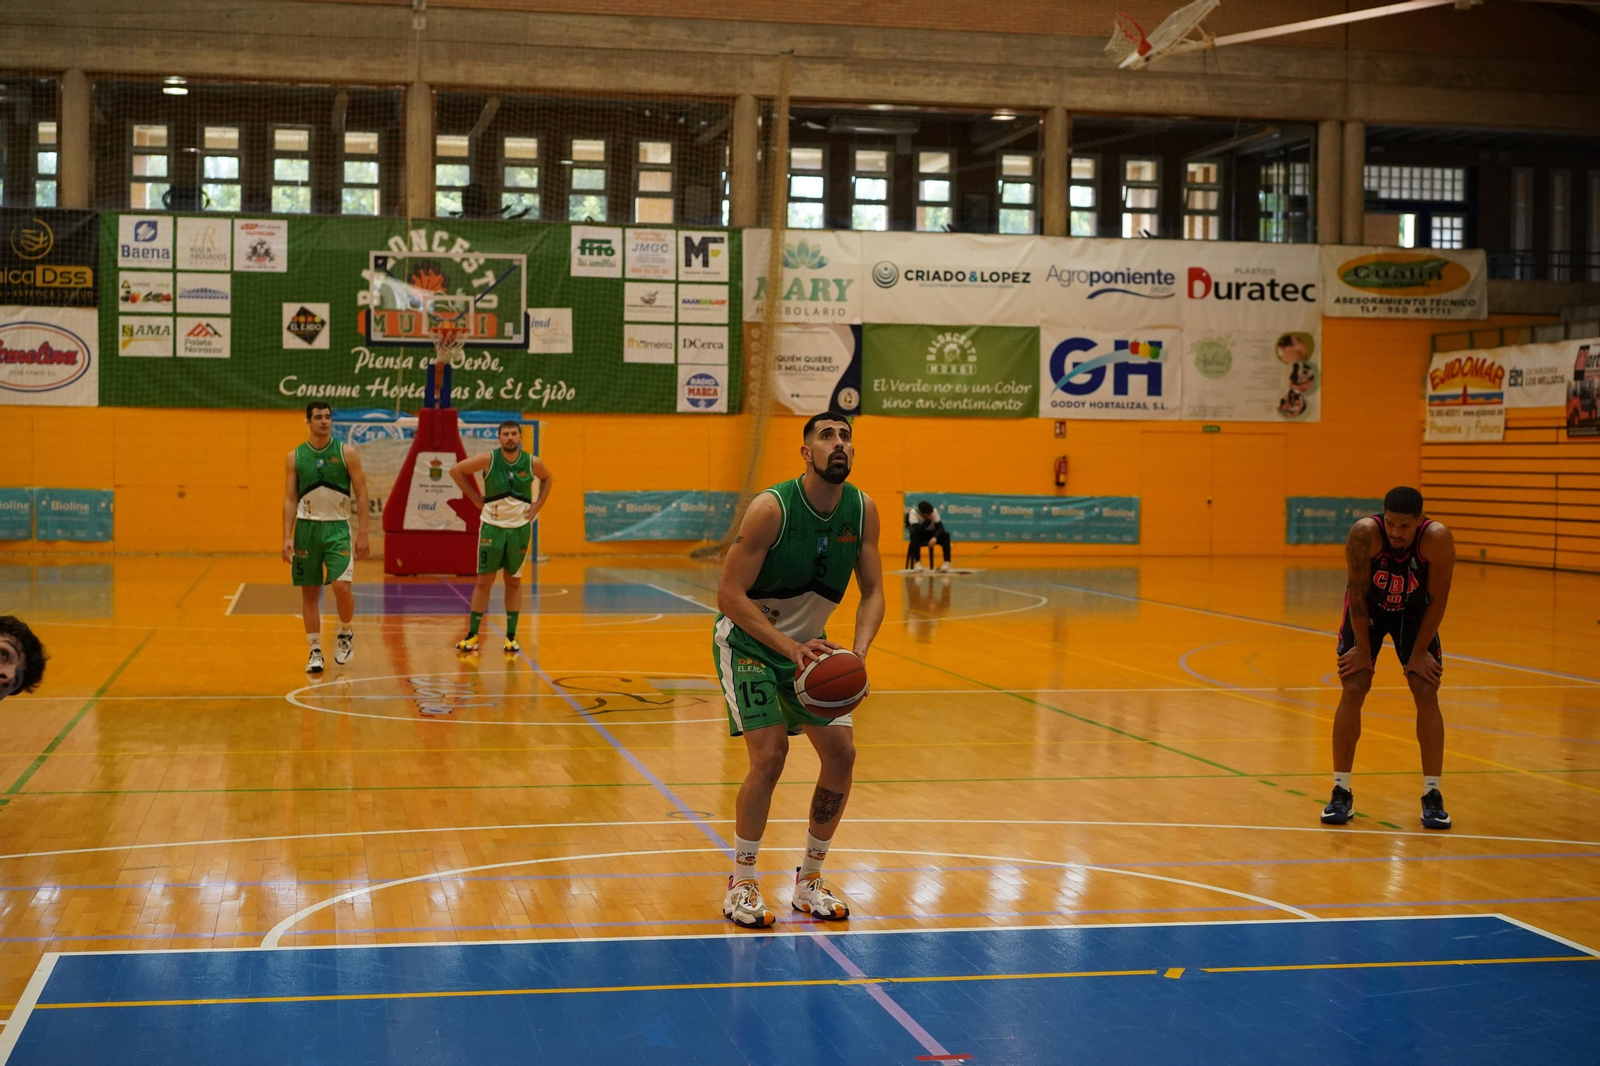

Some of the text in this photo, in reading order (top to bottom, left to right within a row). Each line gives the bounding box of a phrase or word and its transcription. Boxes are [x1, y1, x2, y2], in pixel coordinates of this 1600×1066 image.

[120, 244, 170, 260] Baena
[632, 243, 669, 253] JMGC
[42, 267, 87, 285] Dss
[1046, 265, 1175, 287] Agroponiente
[1187, 267, 1316, 302] Duratec
[350, 346, 414, 375] Piensa
[1049, 337, 1163, 397] GH
[279, 375, 361, 398] Consume
[475, 379, 494, 400] de
[500, 378, 523, 401] El
[528, 378, 576, 408] Ejido
[687, 387, 719, 397] MARCA
[873, 379, 1033, 395] El Verde no es un Color
[882, 398, 912, 410] sino
[938, 397, 1025, 412] Sentimiento
[1051, 400, 1086, 409] GODOY
[1090, 401, 1150, 411] HORTALIZAS,
[51, 501, 90, 511] Bioline
[626, 503, 662, 512] Bioline
[948, 505, 983, 514] Bioline
[1000, 506, 1034, 515] Bioline
[1052, 507, 1085, 516] Bioline
[1103, 508, 1136, 518] Bioline
[296, 561, 305, 577] 5
[738, 680, 768, 709] 15
